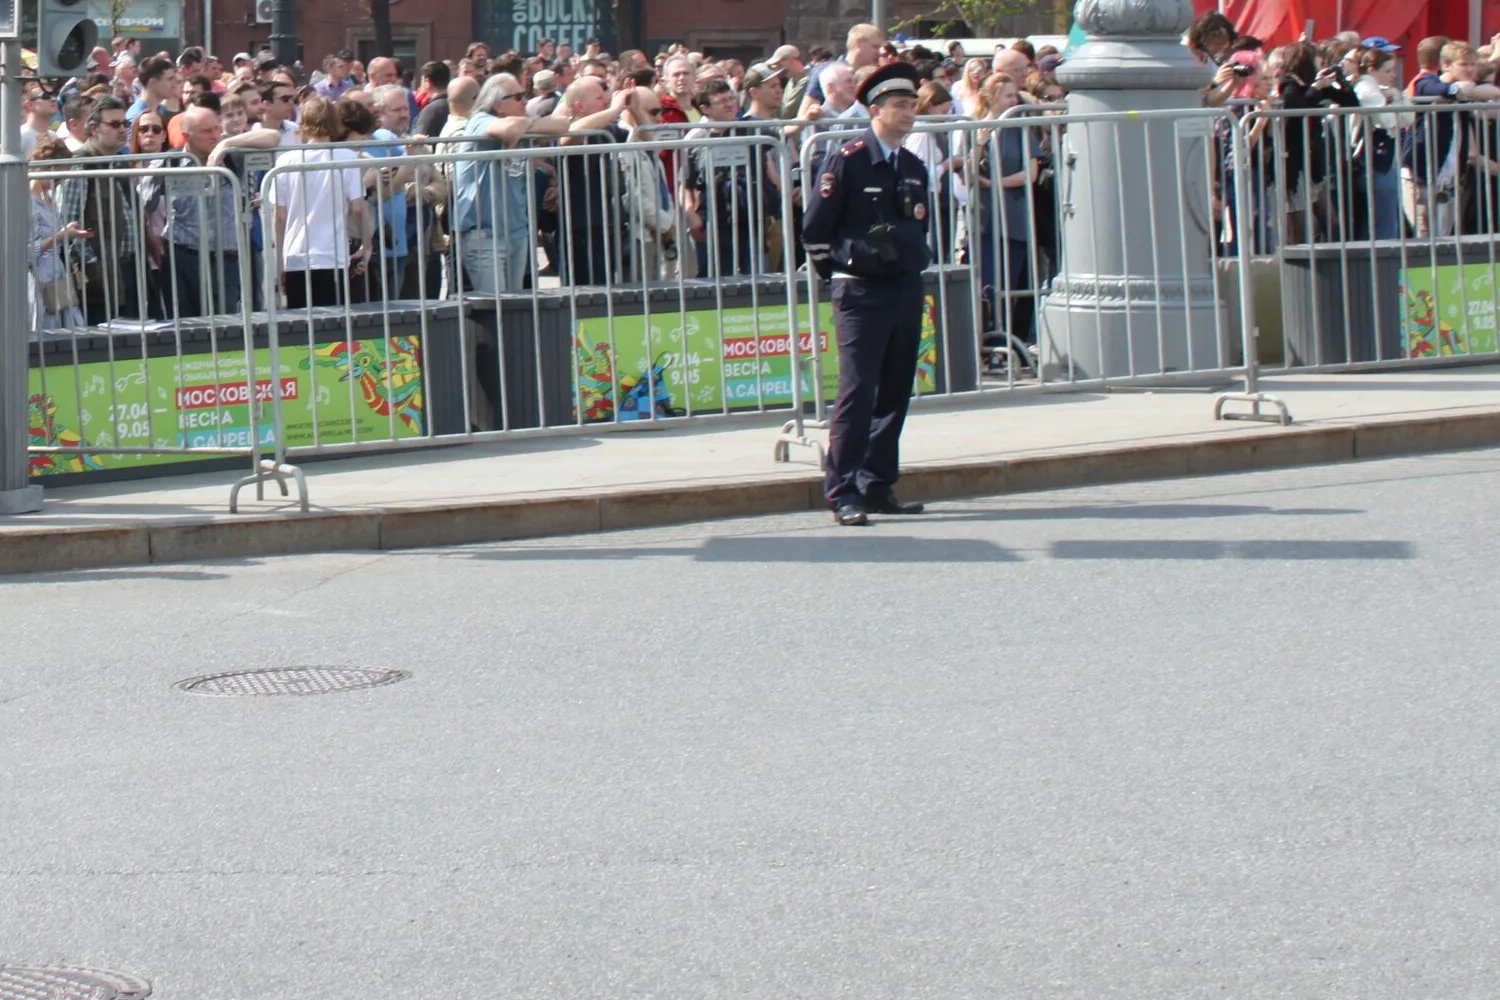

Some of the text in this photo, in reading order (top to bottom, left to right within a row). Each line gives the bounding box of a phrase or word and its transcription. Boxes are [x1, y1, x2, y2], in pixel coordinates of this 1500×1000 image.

[723, 335, 828, 358] МОСКОВКАЯ
[663, 353, 700, 370] 27.4
[725, 360, 772, 377] ВЕСНА
[736, 378, 809, 398] CAPELA
[178, 410, 234, 429] ВЕСНА
[116, 420, 150, 440] 9.05
[193, 429, 276, 448] CAPPELA
